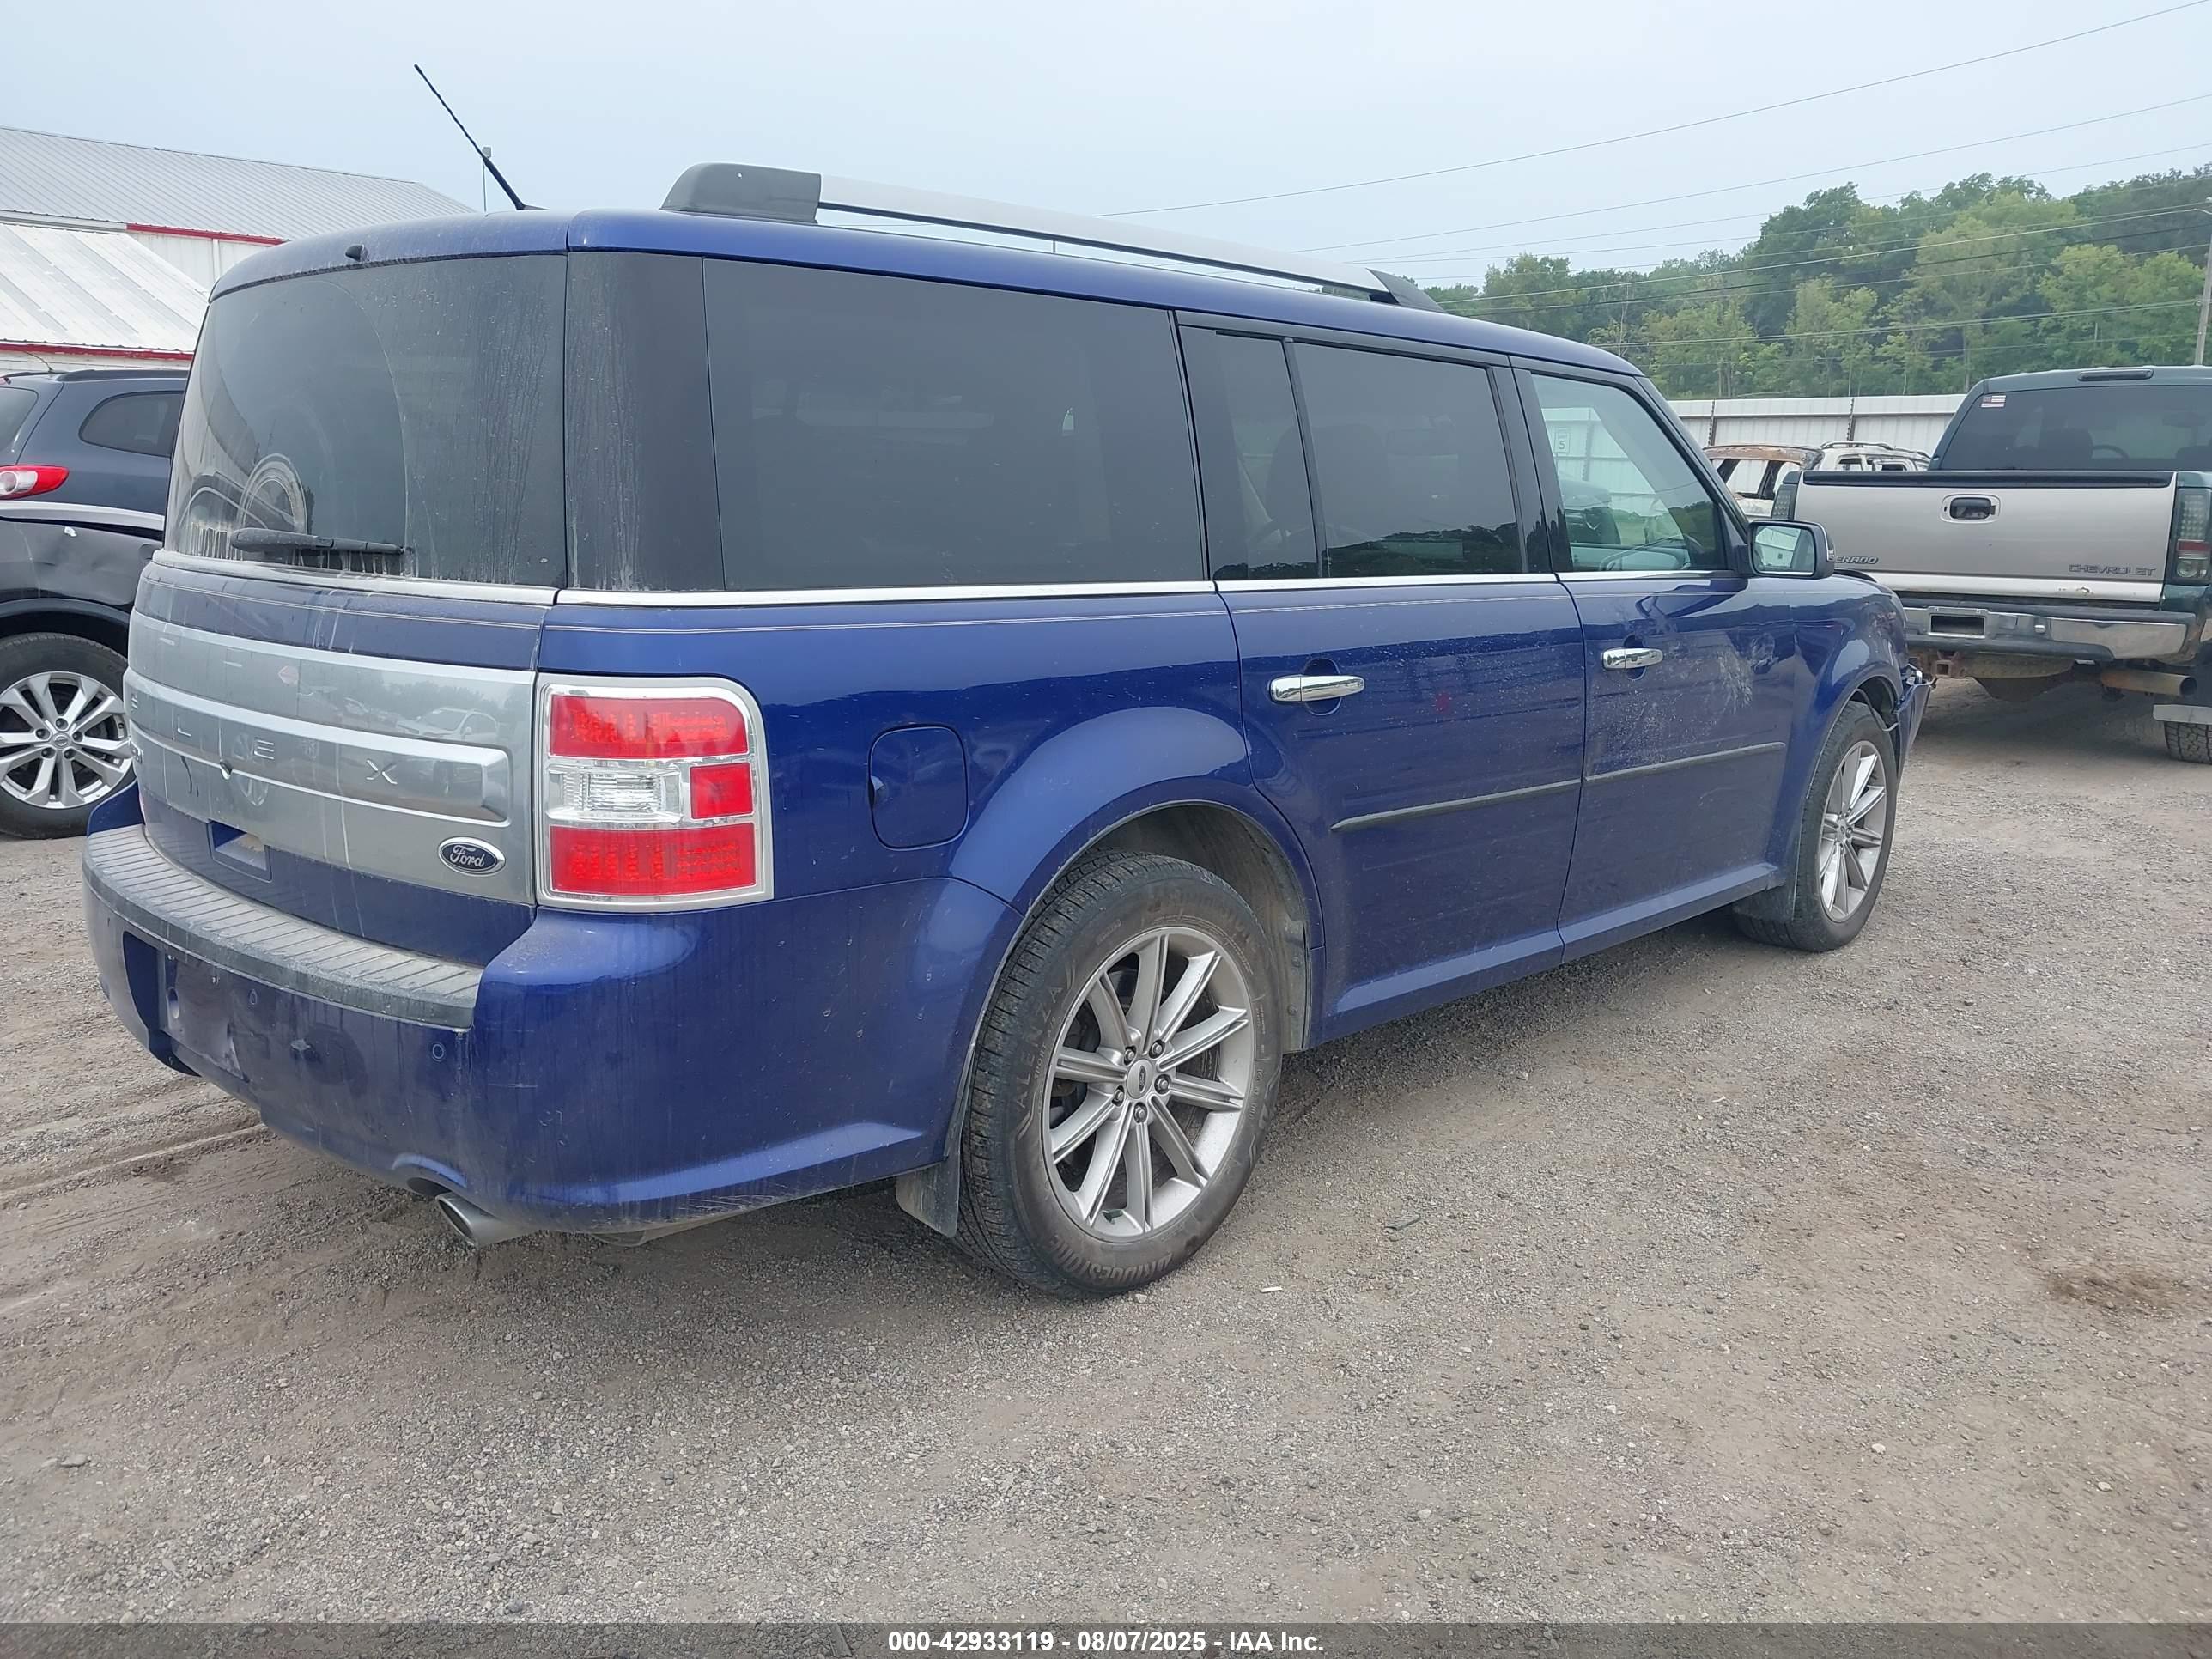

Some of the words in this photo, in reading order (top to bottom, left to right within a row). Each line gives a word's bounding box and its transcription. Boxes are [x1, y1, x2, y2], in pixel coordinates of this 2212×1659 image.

[1834, 556, 1879, 564] ERADO
[2068, 564, 2156, 576] CHEVROLET
[450, 844, 486, 867] Ford
